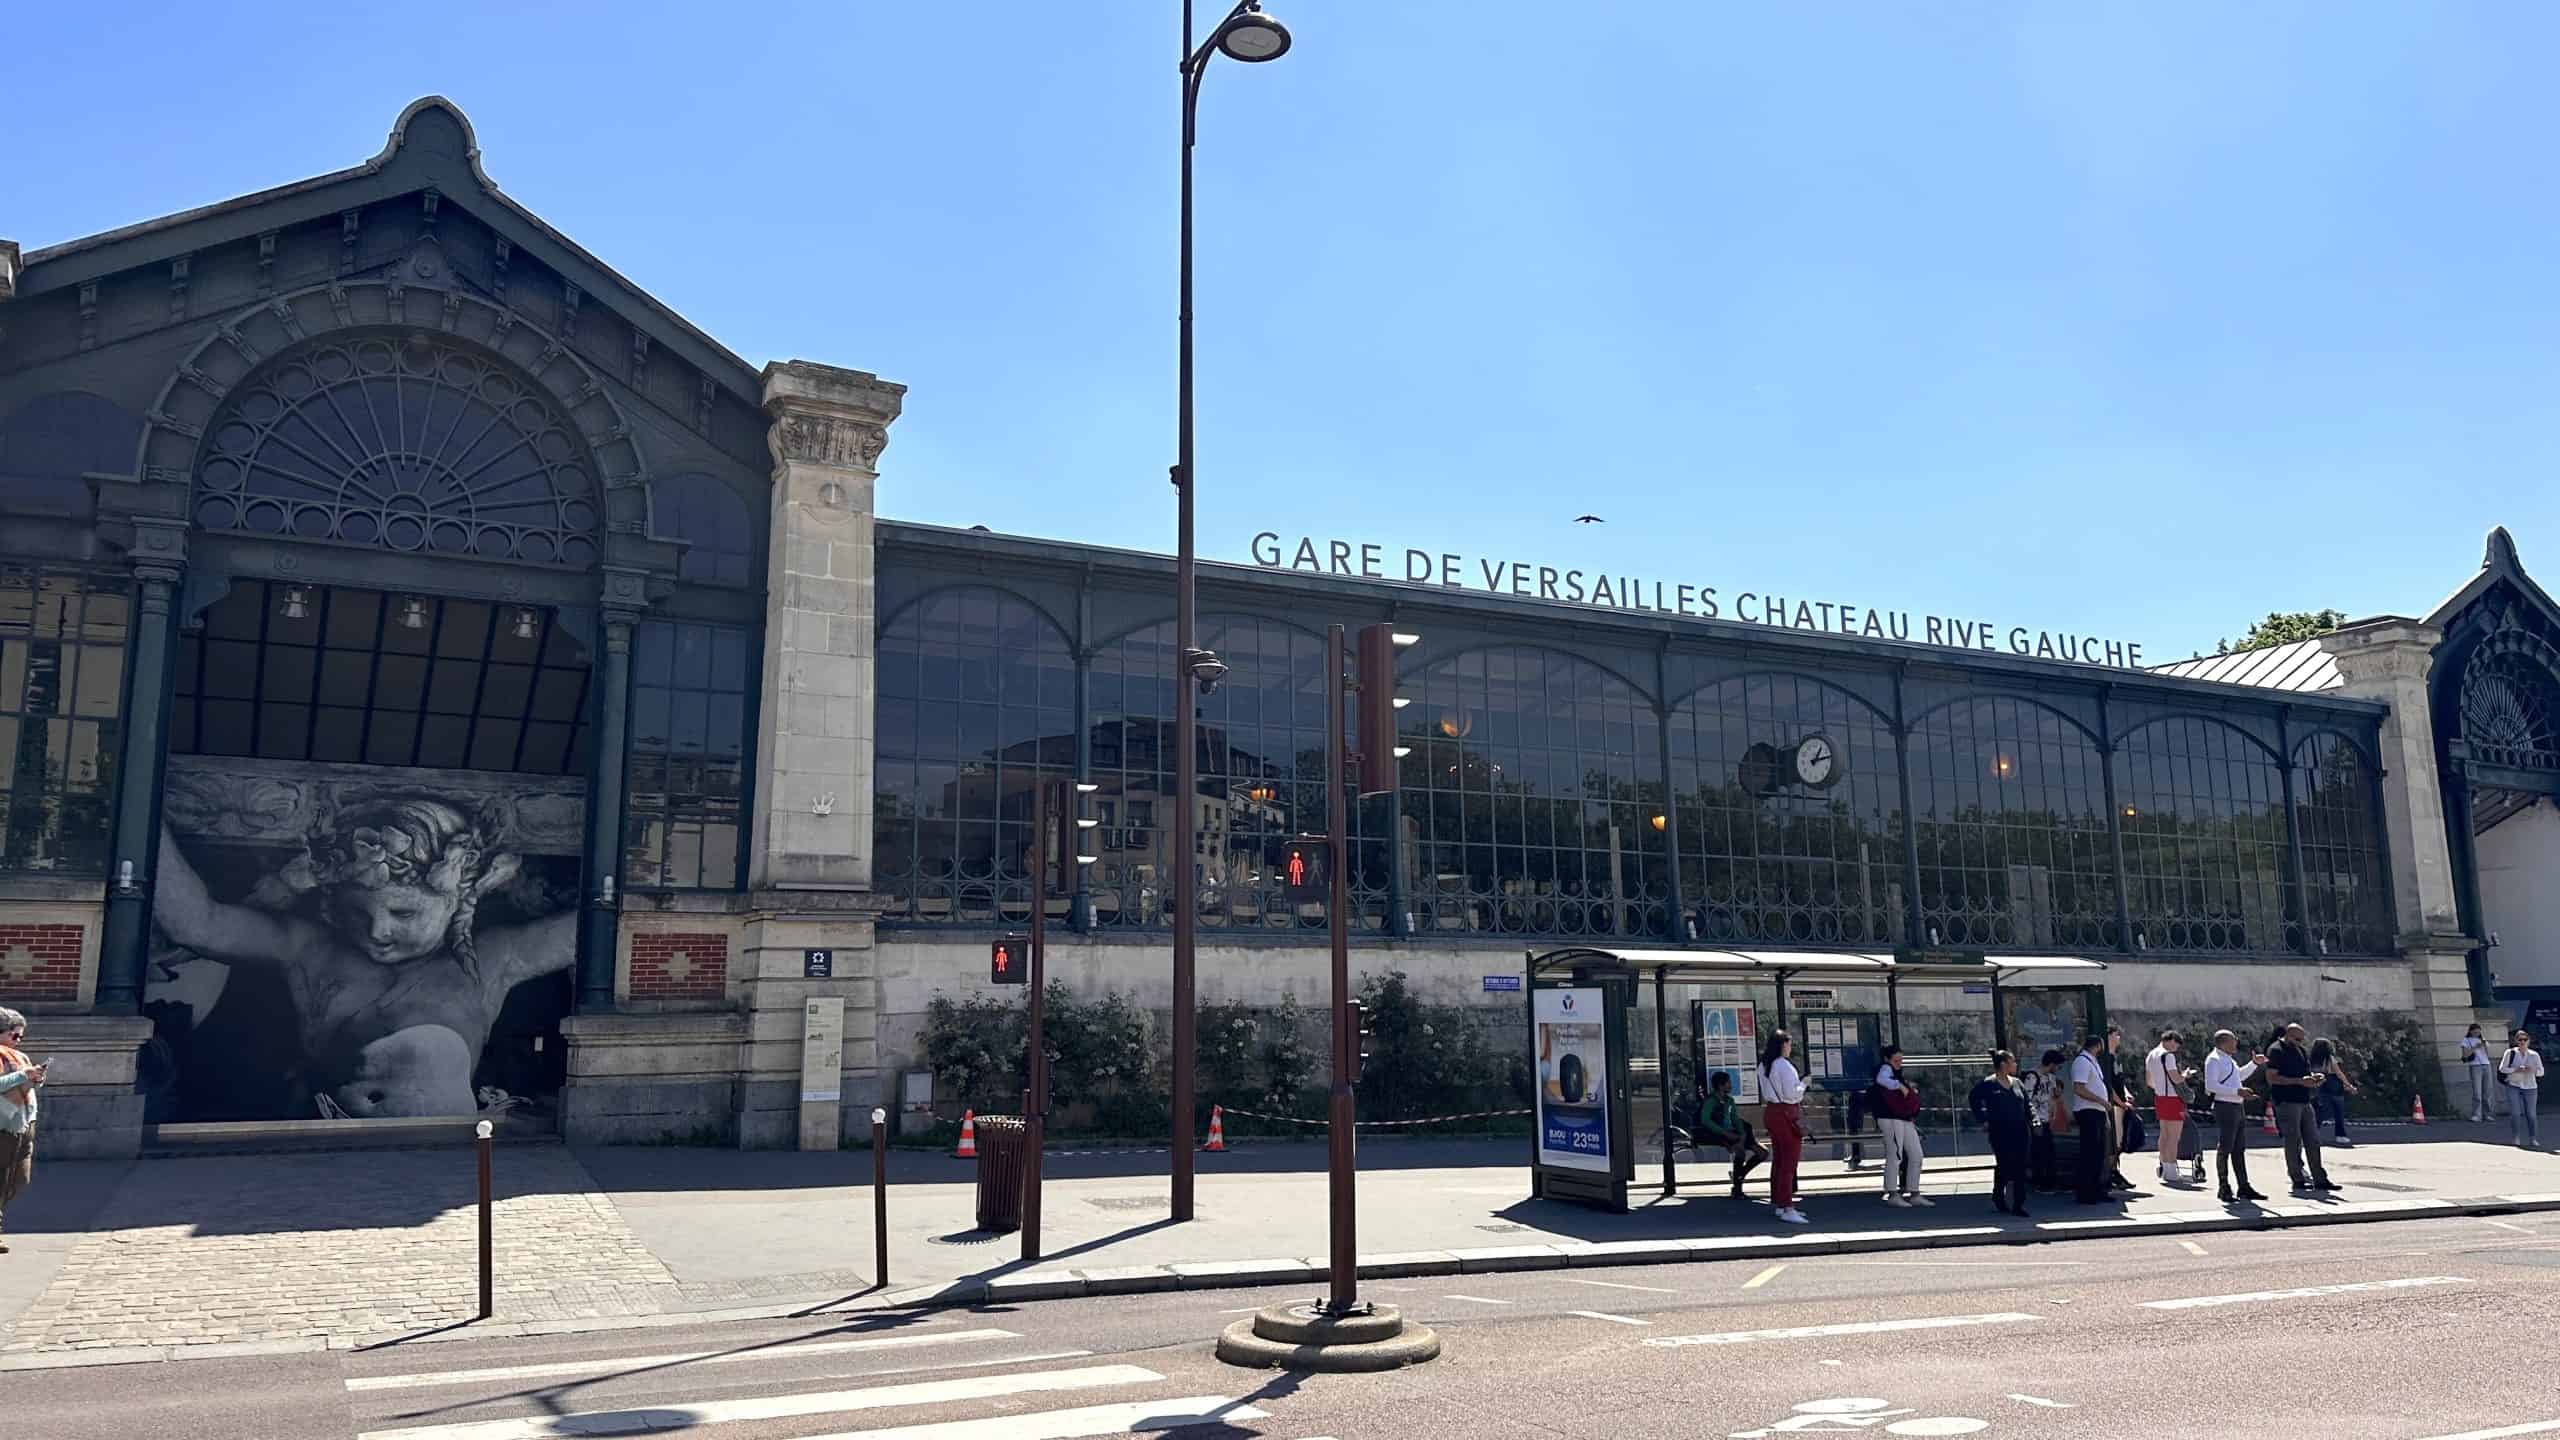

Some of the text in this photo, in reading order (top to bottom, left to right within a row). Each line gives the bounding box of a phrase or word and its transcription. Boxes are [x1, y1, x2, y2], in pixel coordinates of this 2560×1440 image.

[1251, 532, 2143, 669] GARE DE VERSAILLES CHATEAU RIVE GAUCHE
[1573, 1132, 1587, 1148] 23
